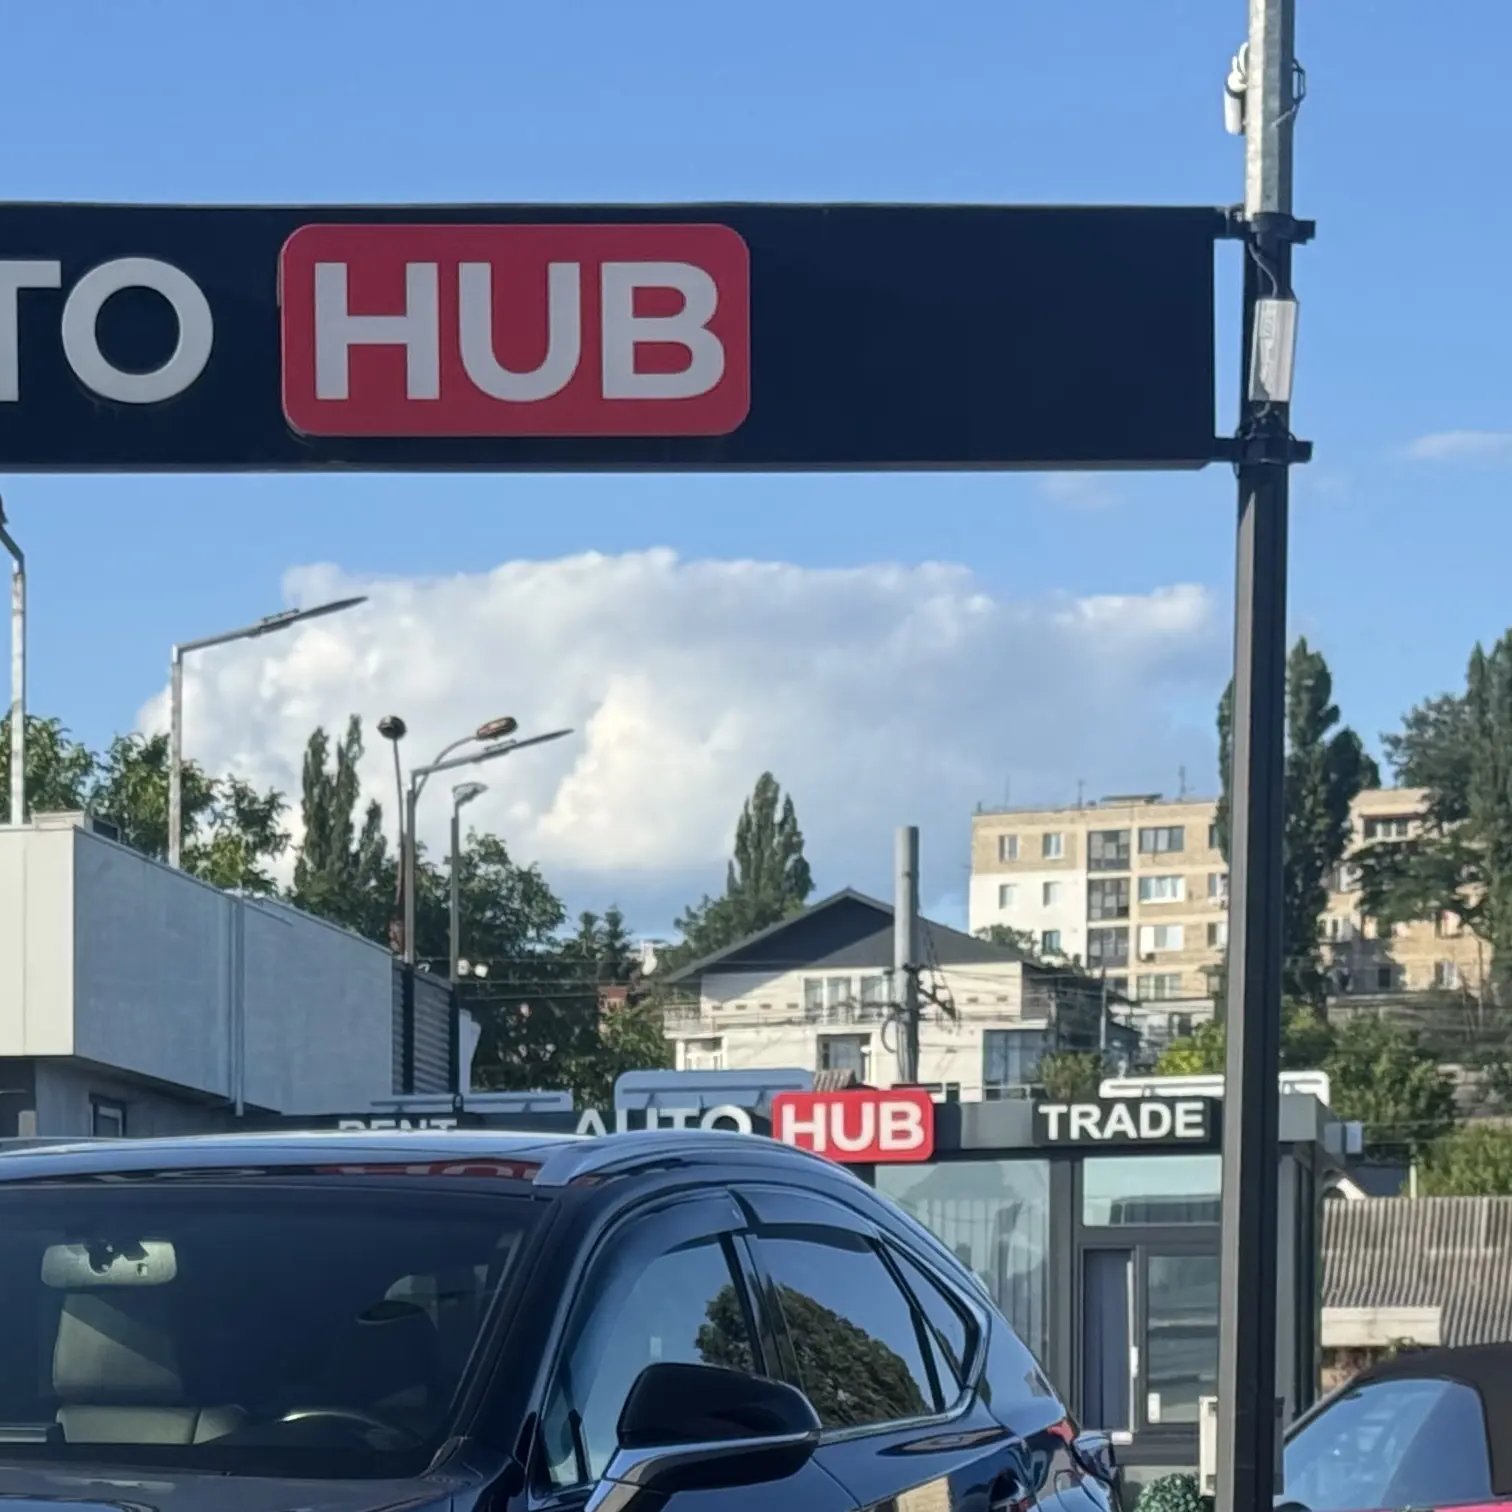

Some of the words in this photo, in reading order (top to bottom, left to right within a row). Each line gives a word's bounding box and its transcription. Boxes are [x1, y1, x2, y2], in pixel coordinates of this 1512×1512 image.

[315, 260, 726, 401] HUB
[781, 1101, 925, 1152] HUB
[1038, 1101, 1205, 1140] TRADE
